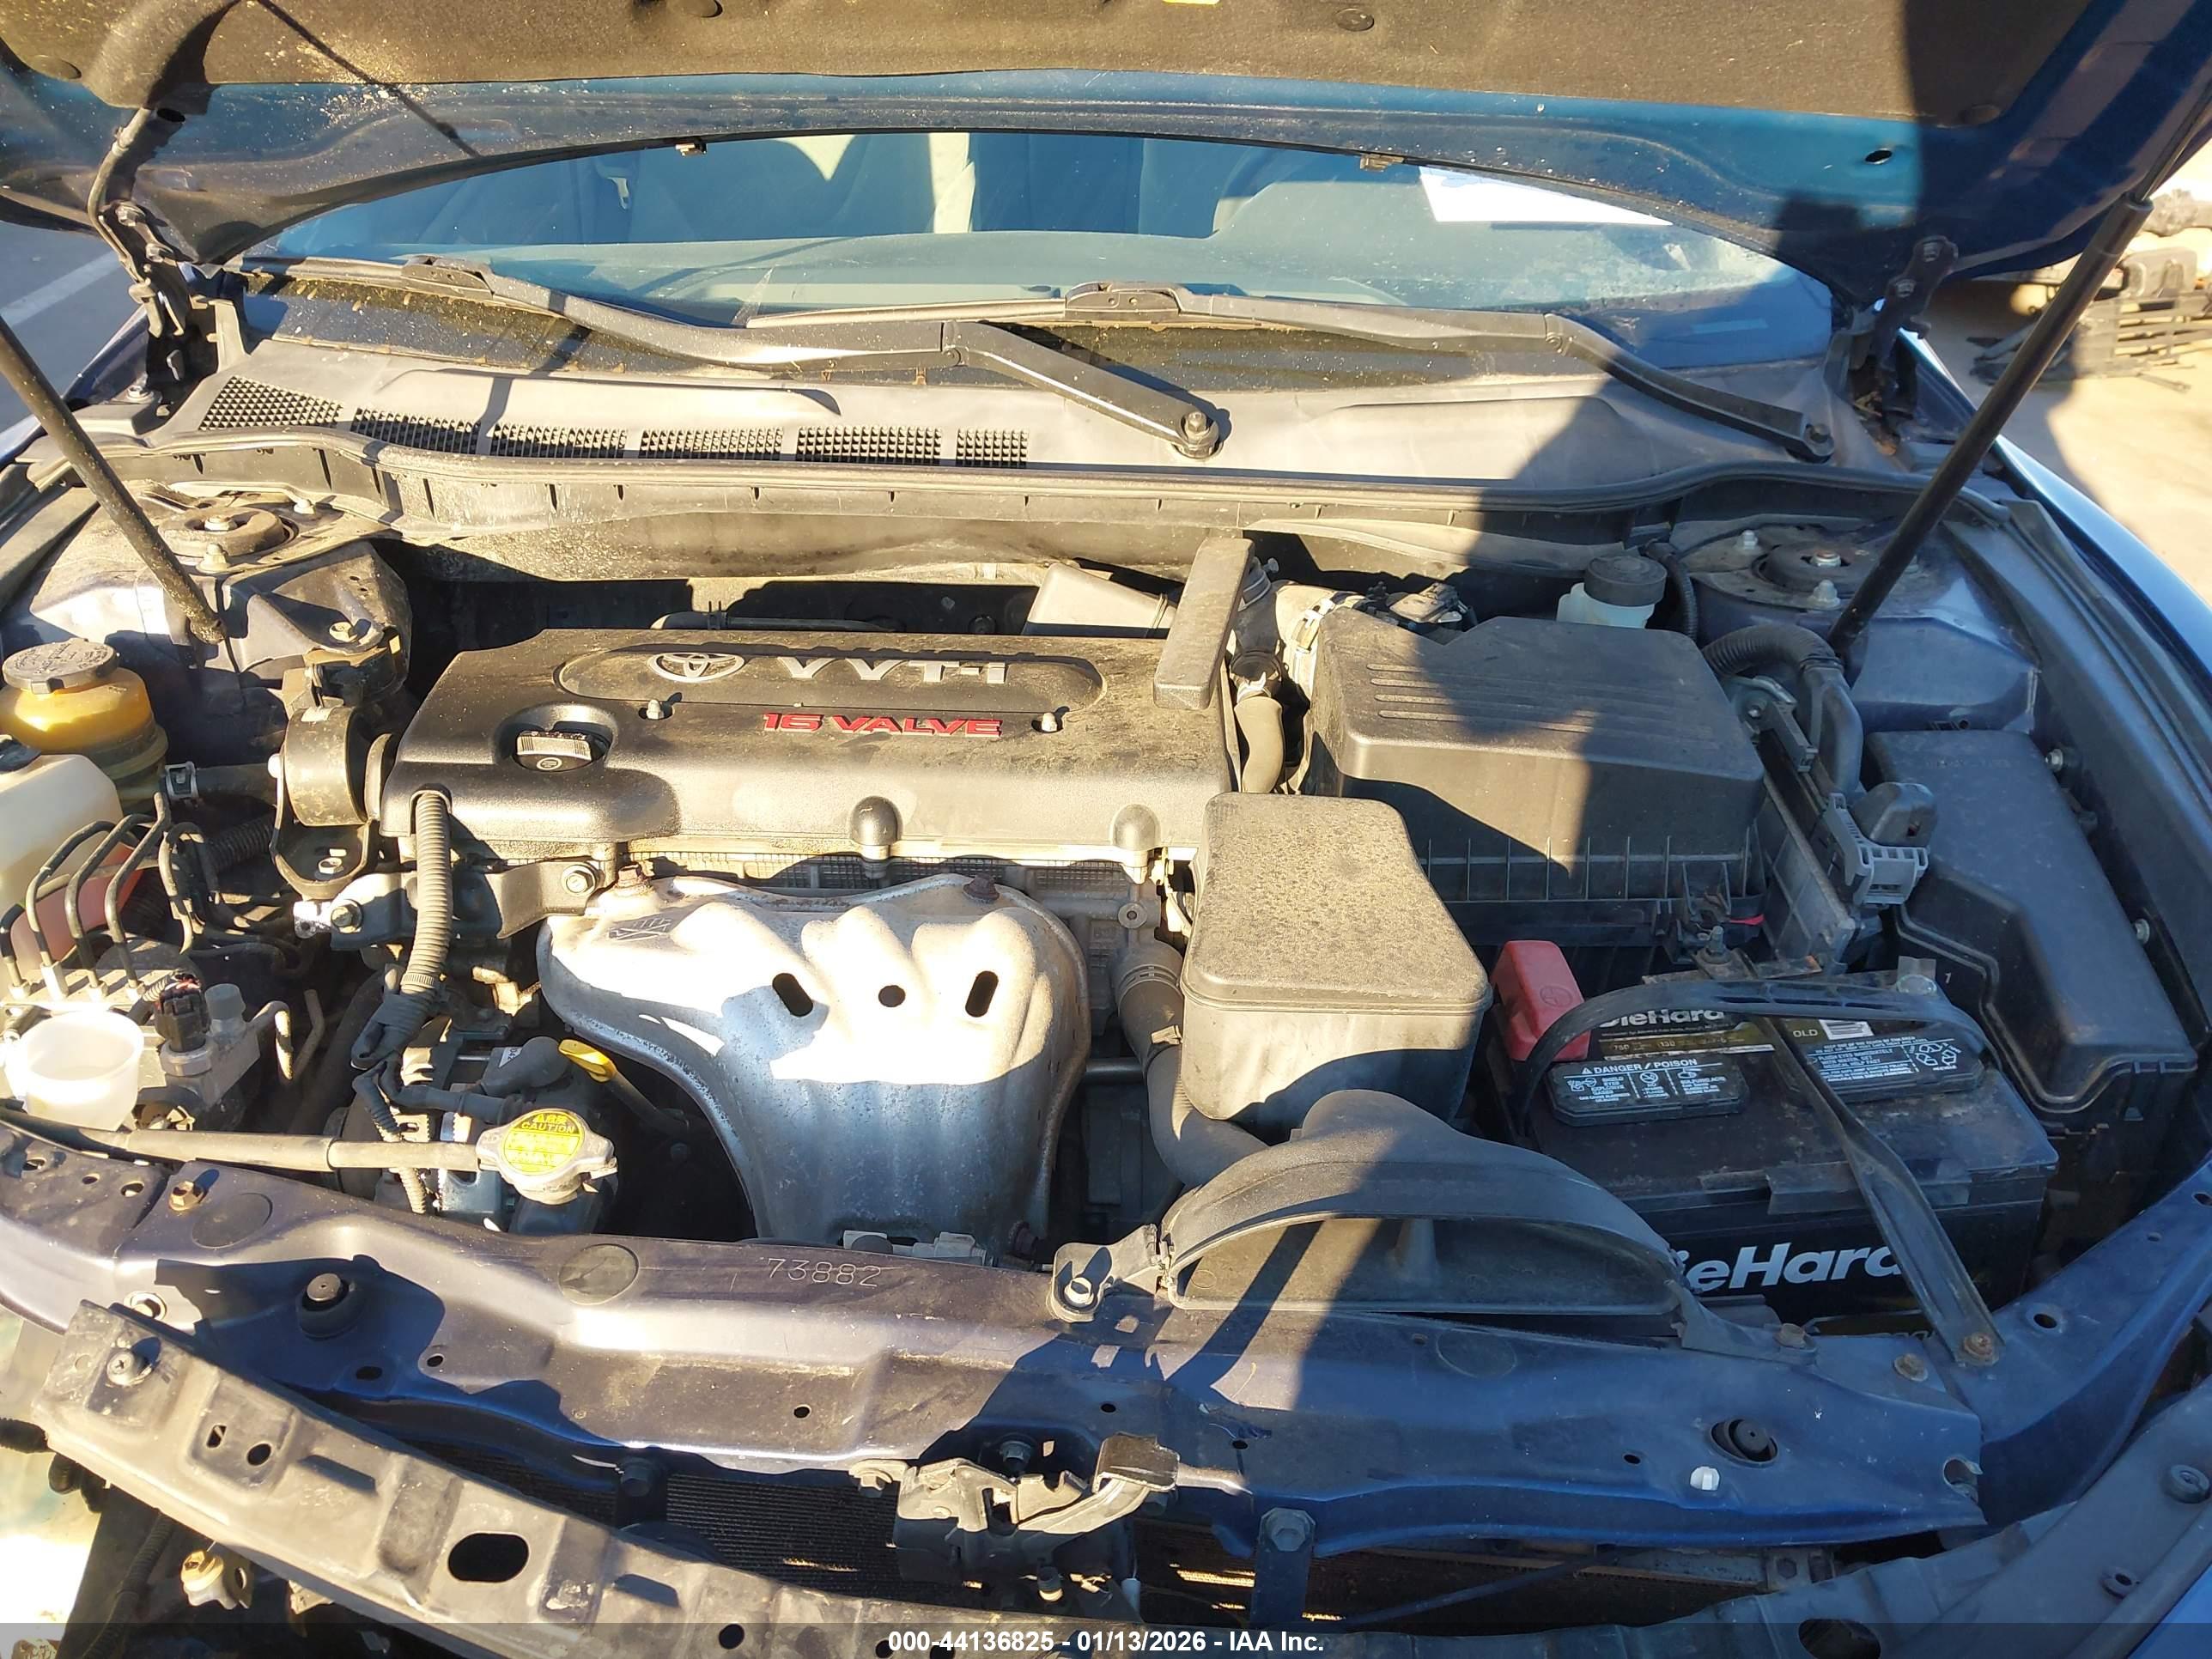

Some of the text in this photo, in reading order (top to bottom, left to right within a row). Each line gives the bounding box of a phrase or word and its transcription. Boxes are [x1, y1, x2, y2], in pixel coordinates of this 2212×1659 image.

[763, 714, 1003, 738] 16 VALVE
[1792, 1029, 1818, 1037] OLD
[1593, 1063, 1642, 1074] DANGER
[1654, 1059, 1698, 1069] POISON
[521, 1121, 574, 1133] CAUTION
[768, 1257, 881, 1288] 73882
